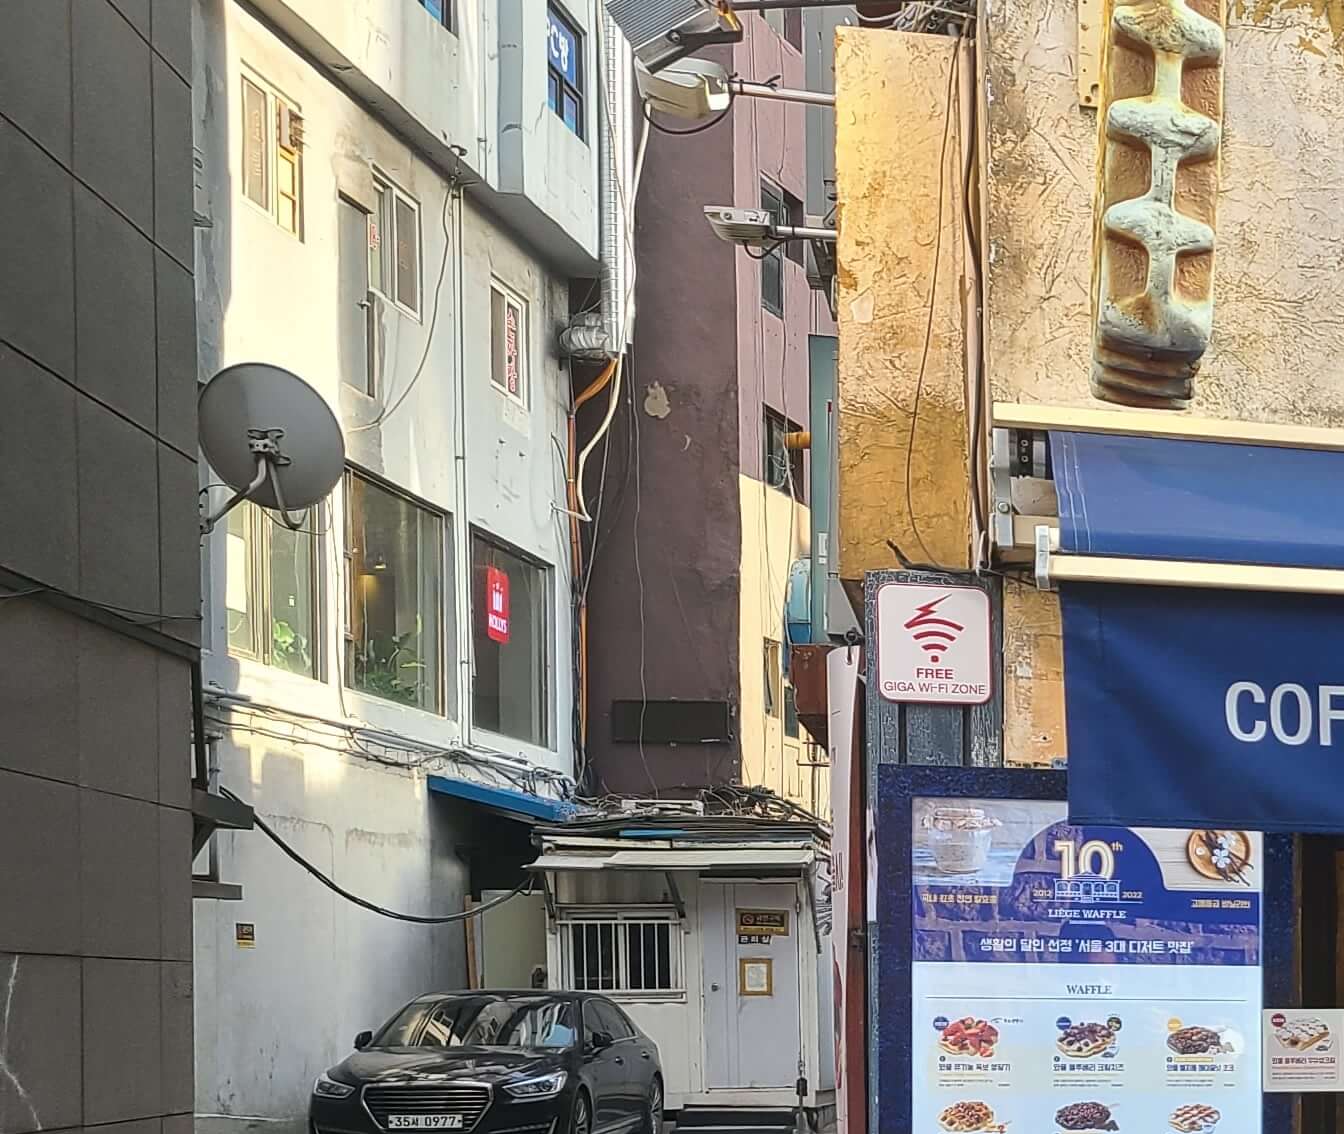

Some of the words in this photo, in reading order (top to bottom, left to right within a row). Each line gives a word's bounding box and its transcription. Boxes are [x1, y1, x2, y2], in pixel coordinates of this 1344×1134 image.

[916, 668, 954, 680] FREE
[883, 681, 915, 692] GIGA
[951, 684, 985, 695] ZONE
[1082, 909, 1128, 920] WAFFLE
[980, 937, 1017, 952] 생활의
[1020, 938, 1045, 952] 달인
[1047, 938, 1073, 953] 선정
[1105, 940, 1126, 953] 3대
[1129, 940, 1165, 954] 디저트
[1066, 984, 1112, 995] WAFFLE
[424, 1116, 457, 1127] 0977
